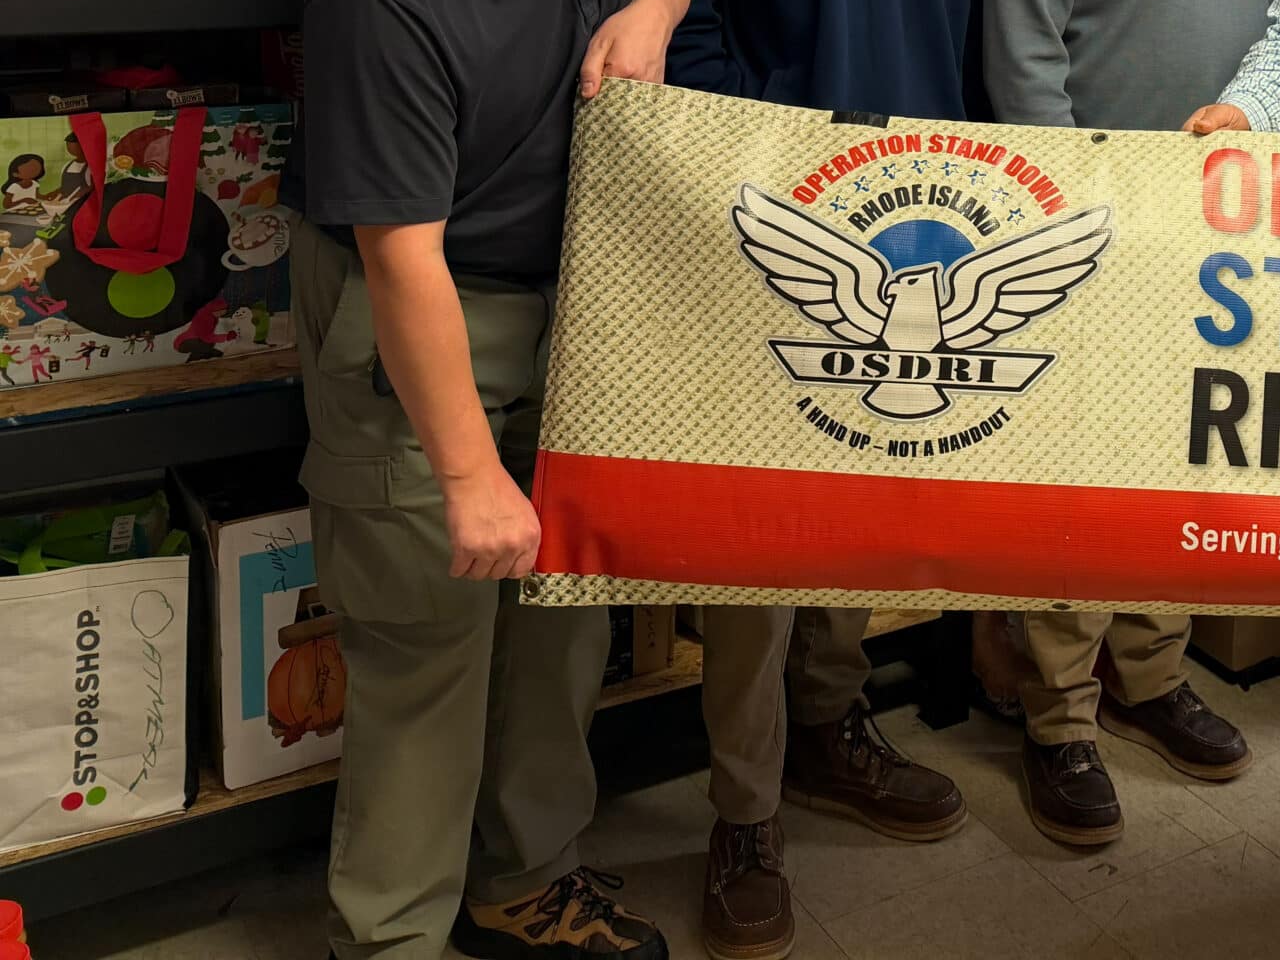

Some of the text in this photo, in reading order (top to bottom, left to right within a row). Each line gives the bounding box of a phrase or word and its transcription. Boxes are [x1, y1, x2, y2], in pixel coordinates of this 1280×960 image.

[792, 134, 1069, 217] OPERATION STAND DOWN
[848, 183, 1003, 237] RHODE ISLAND
[820, 351, 997, 383] OSDRI
[796, 396, 811, 413] A
[805, 406, 847, 441] HAND
[848, 429, 872, 451] UP
[887, 438, 919, 458] NOT
[923, 439, 934, 457] A
[937, 406, 1012, 455] HANDOUT
[73, 609, 101, 786] STOP&SHOP
